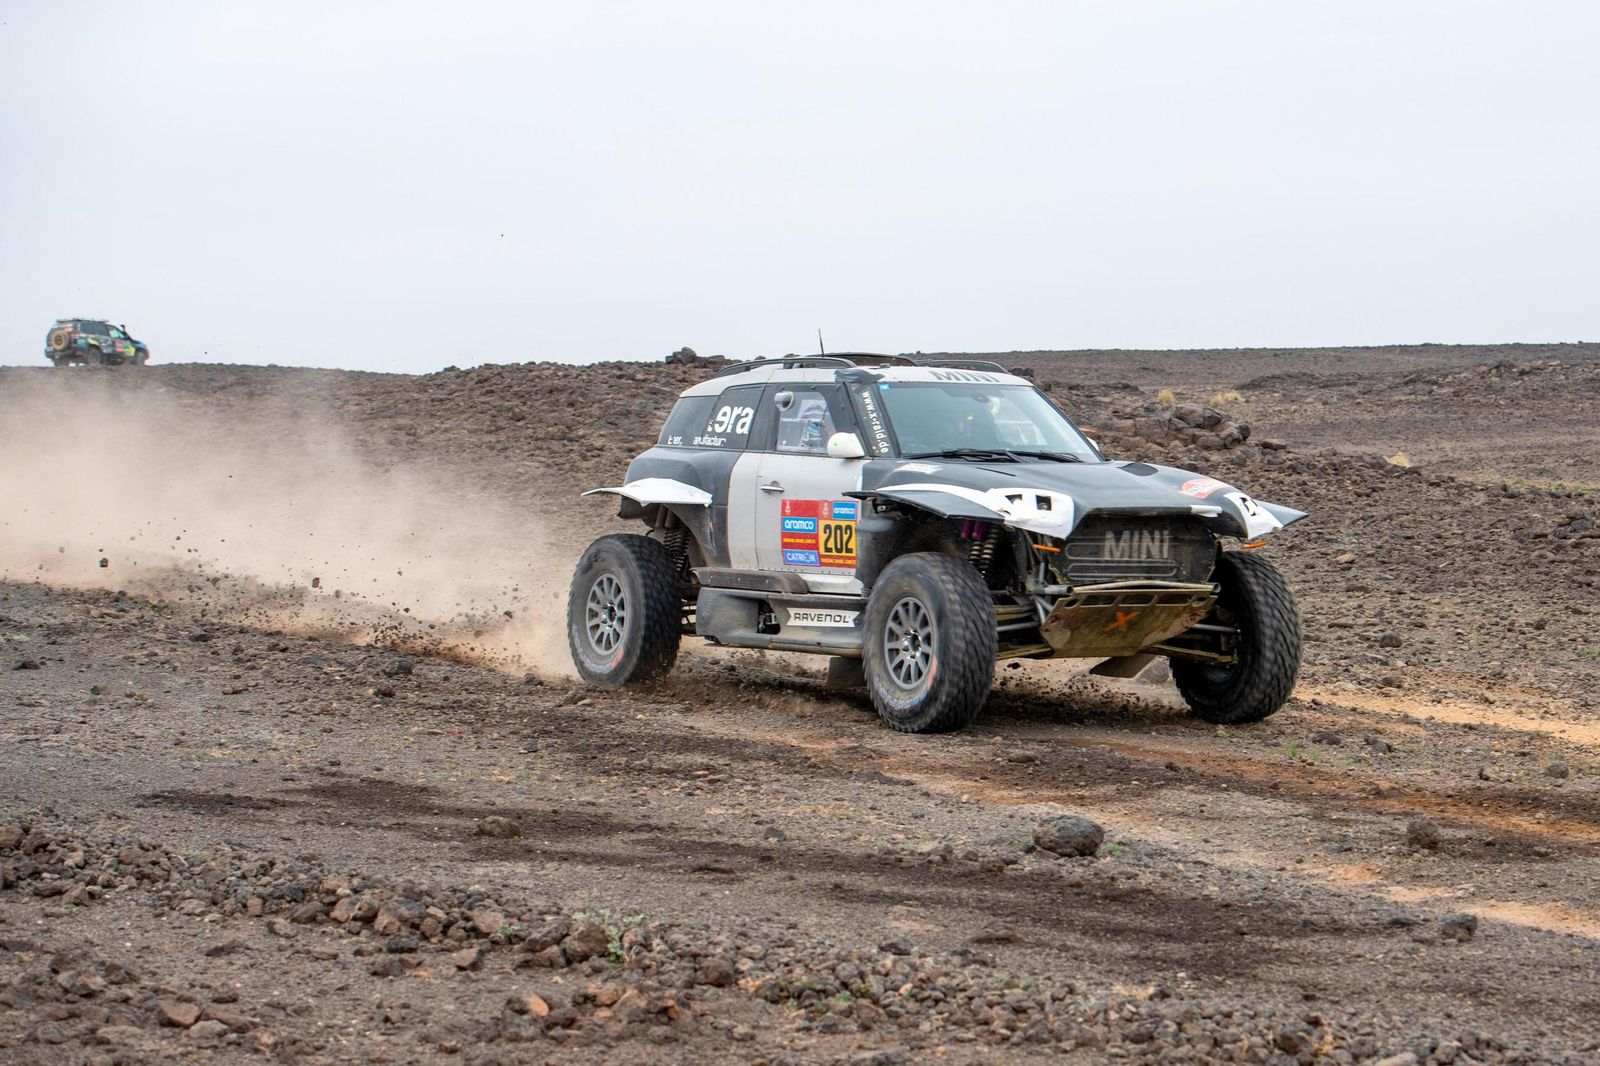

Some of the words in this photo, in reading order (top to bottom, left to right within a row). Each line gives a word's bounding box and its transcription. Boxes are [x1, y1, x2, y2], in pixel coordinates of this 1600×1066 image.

[784, 520, 814, 530] aramco
[823, 523, 854, 554] 202
[1103, 530, 1169, 561] MINI
[793, 612, 850, 624] RAVENOL
